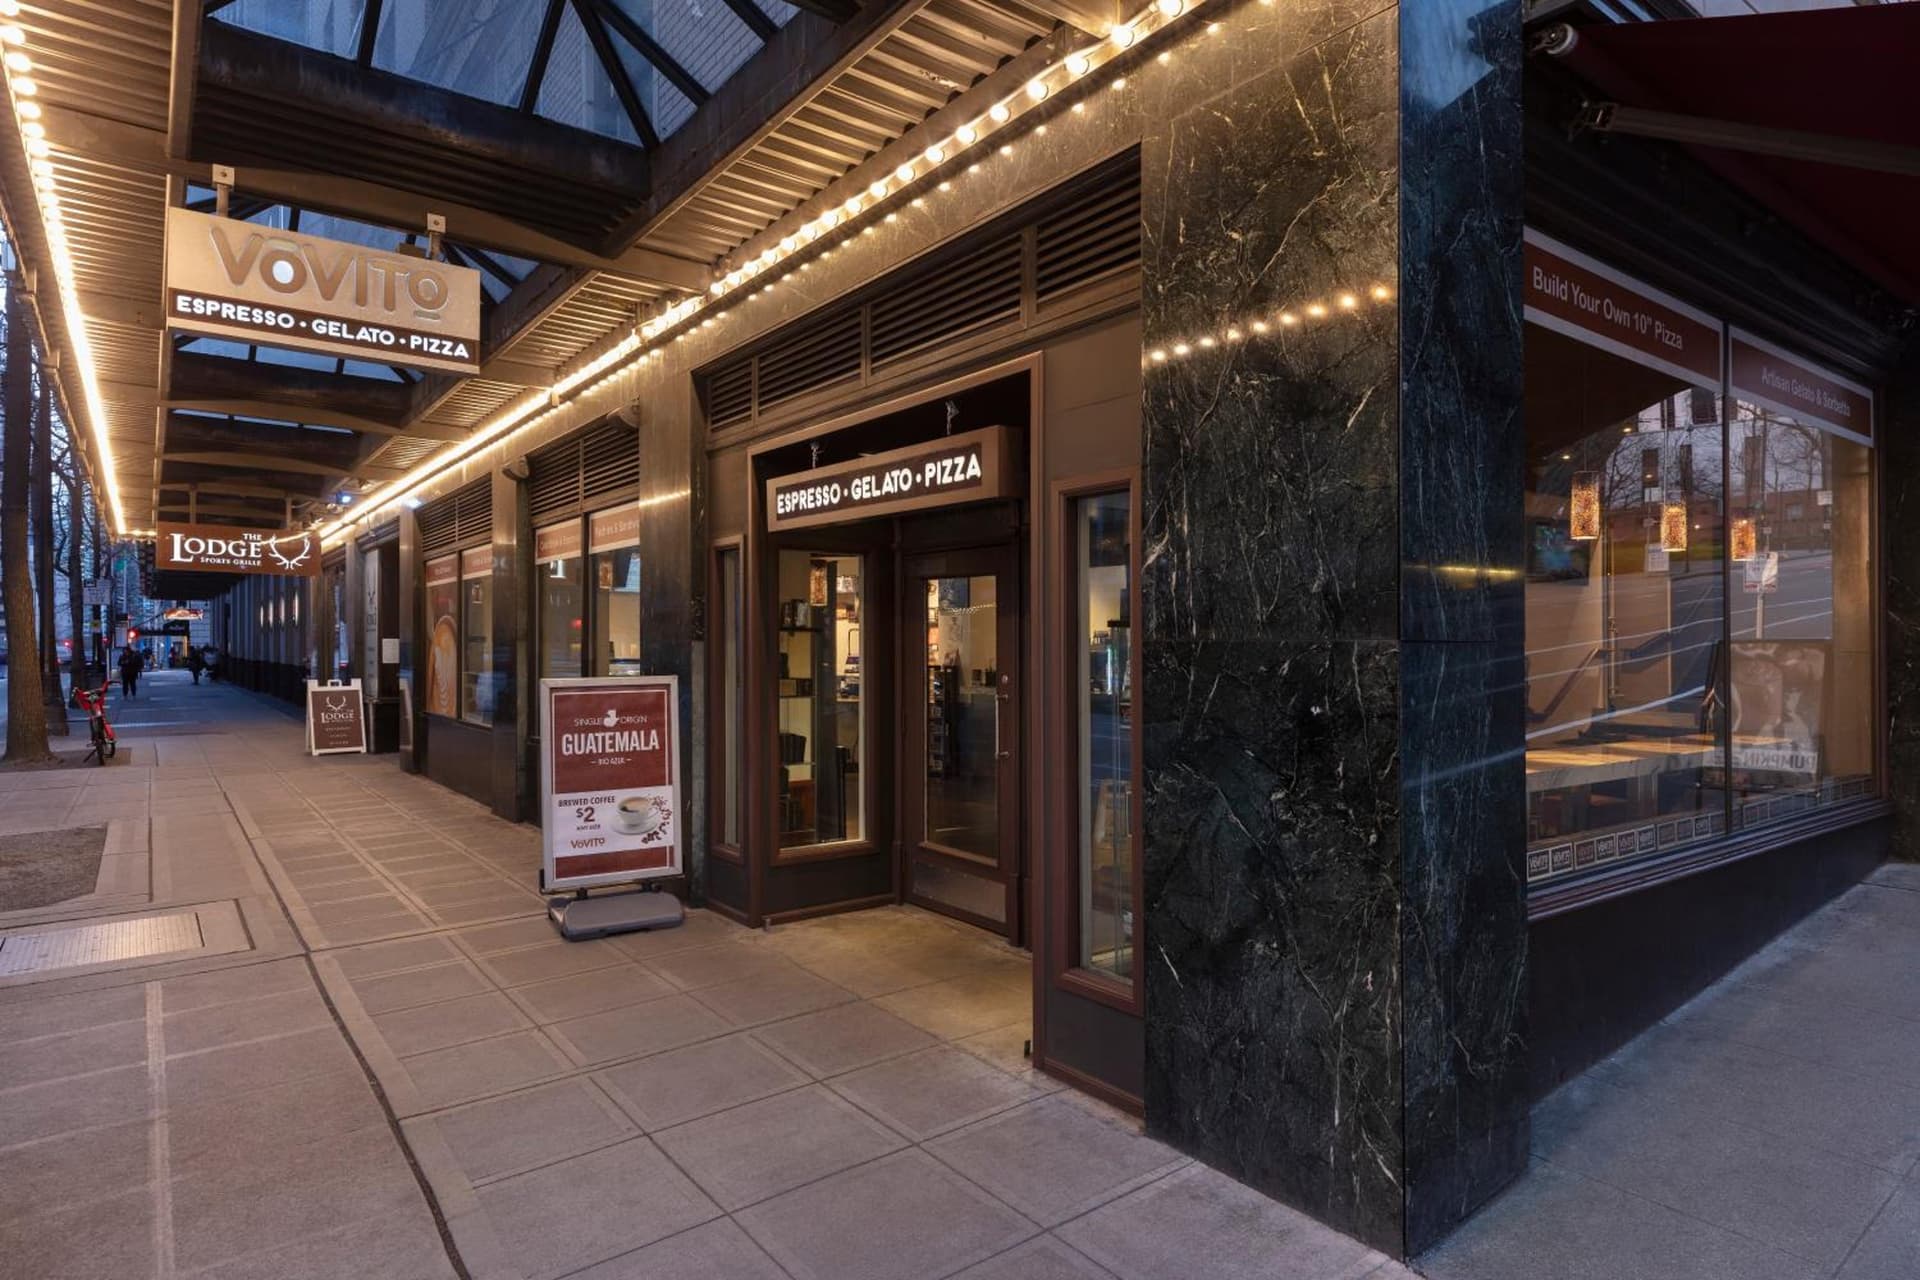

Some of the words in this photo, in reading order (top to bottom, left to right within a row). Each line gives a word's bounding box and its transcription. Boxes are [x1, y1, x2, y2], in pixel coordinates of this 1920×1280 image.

[1533, 265, 1568, 301] Build
[1571, 283, 1600, 313] Your
[1603, 298, 1630, 328] Own
[1655, 320, 1683, 350] Pizza
[176, 295, 295, 329] ESPRESSO
[311, 318, 395, 345] GELATO
[410, 334, 469, 359] PIZZA
[777, 483, 841, 514] ESPRESSO
[851, 468, 912, 500] GELATO
[925, 453, 982, 487] PIZZA
[170, 533, 262, 562] LODGE
[243, 533, 262, 541] THE
[574, 717, 601, 727] SINGLE
[620, 715, 647, 724] ORIGIN
[562, 729, 660, 756] GUATEMALA
[558, 797, 588, 807] BREWED
[590, 795, 615, 804] COFFEE
[576, 806, 595, 823] $2
